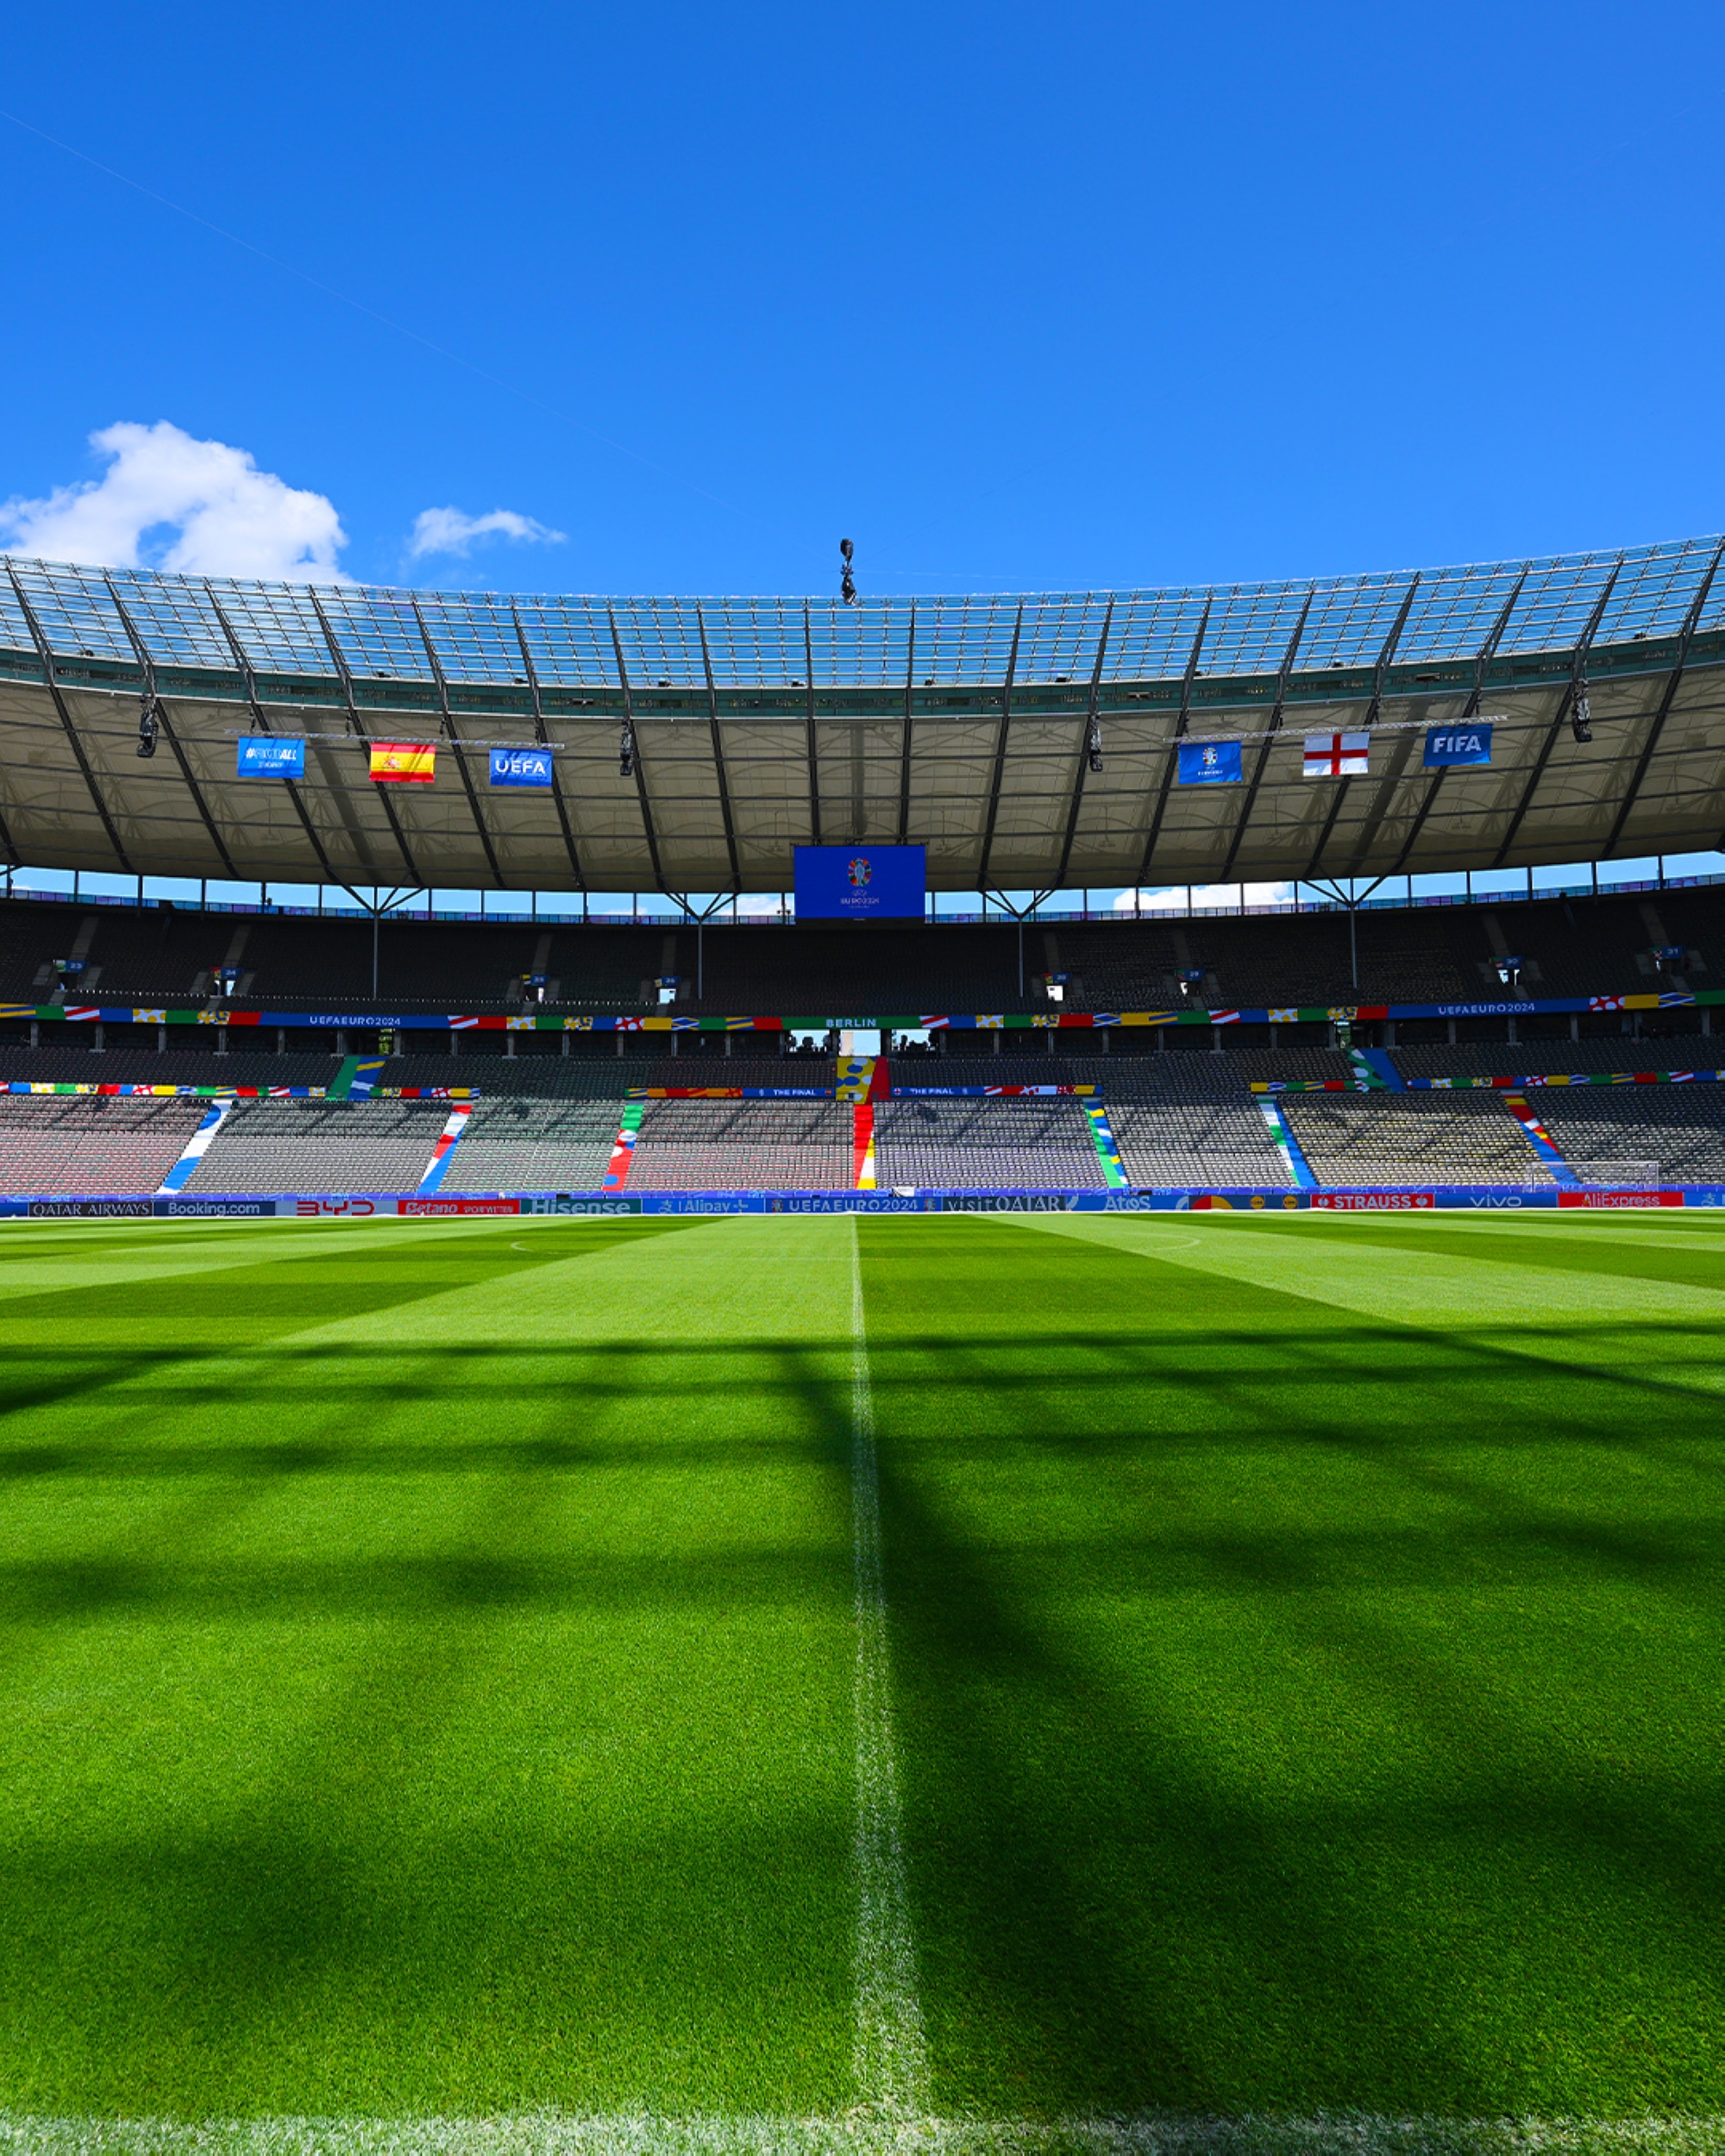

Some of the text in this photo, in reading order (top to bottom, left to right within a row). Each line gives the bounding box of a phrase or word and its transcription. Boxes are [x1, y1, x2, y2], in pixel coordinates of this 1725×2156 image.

[1433, 735, 1482, 754] FIFA
[495, 760, 546, 774] UEFA
[825, 1018, 877, 1028] BERLIN
[531, 1200, 630, 1214] Hisense
[1333, 1196, 1412, 1208] STRAUSS
[1582, 1193, 1660, 1207] AliExpress
[33, 1204, 150, 1216] QATAR AIRWAYS
[167, 1202, 260, 1216] Booking.com
[297, 1200, 375, 1216] BYD
[405, 1202, 458, 1214] Betano
